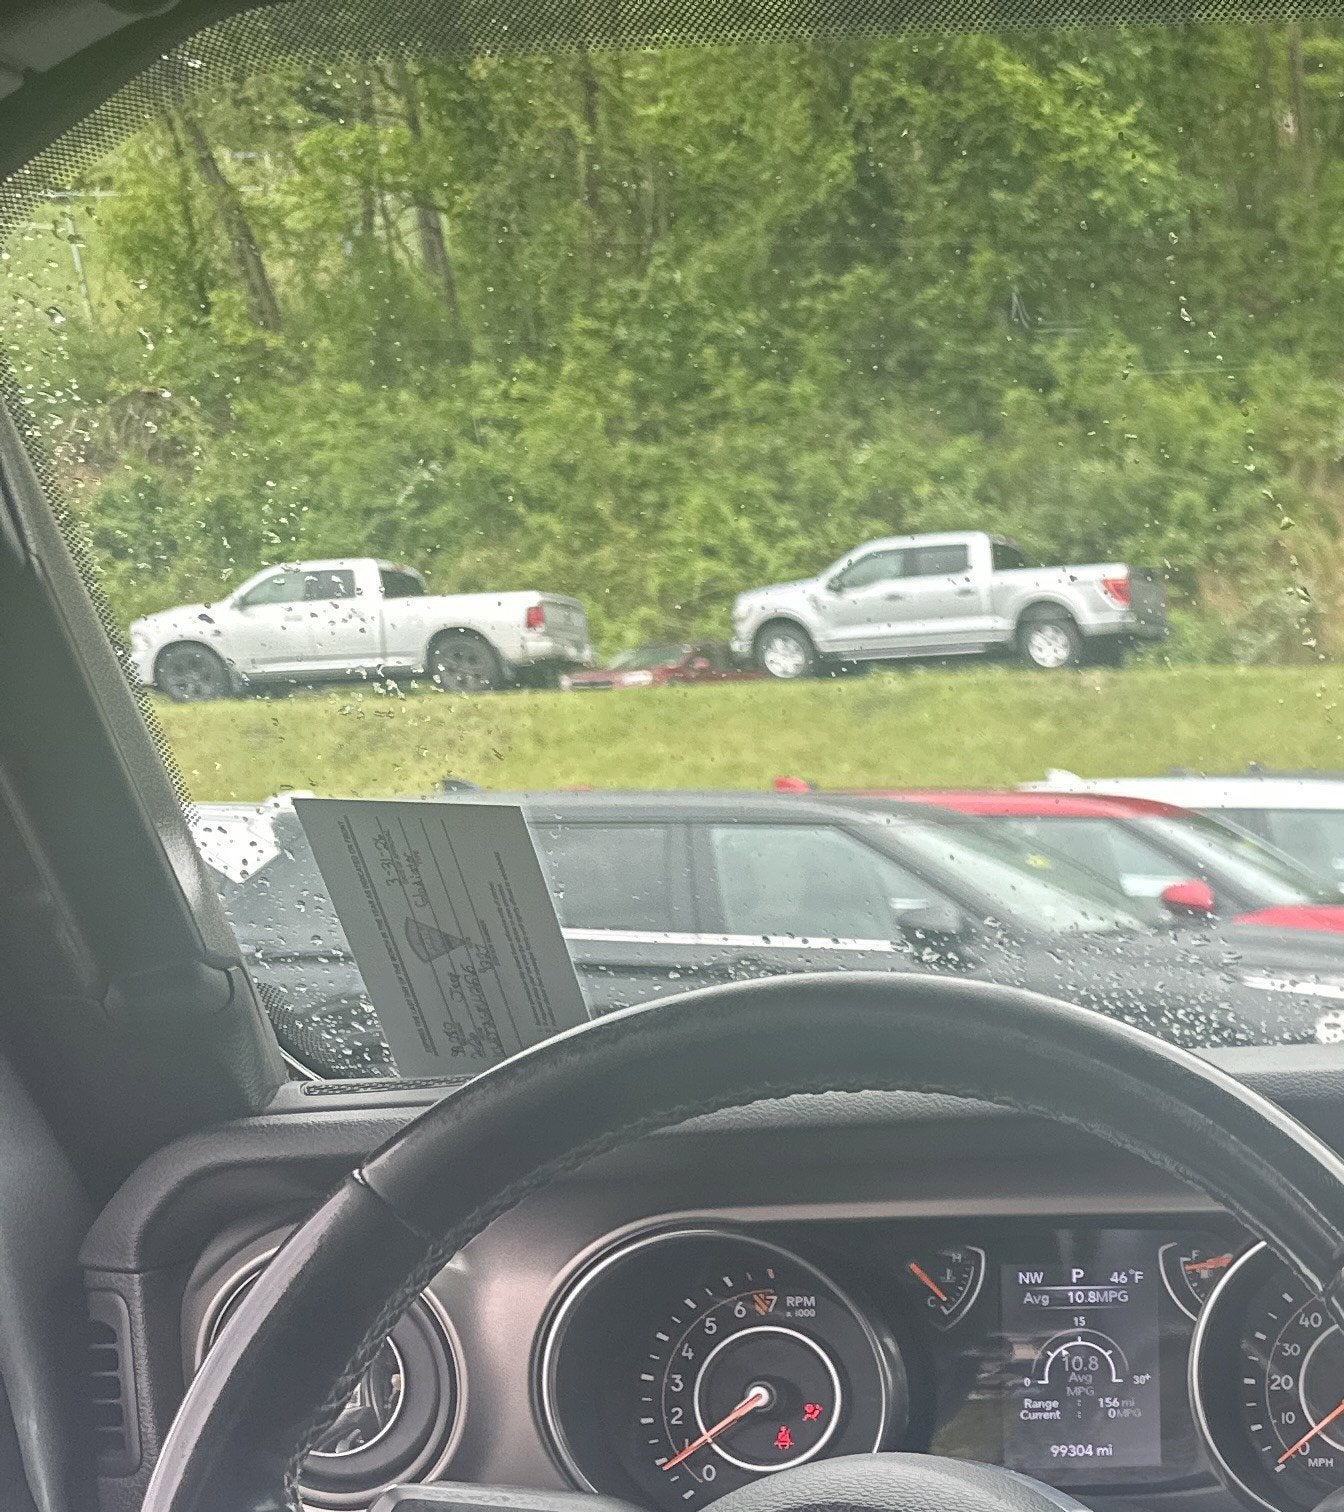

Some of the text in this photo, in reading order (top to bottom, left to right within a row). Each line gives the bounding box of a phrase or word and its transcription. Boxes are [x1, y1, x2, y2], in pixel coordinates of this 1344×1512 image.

[1018, 1272, 1043, 1284] NW
[1071, 1268, 1085, 1283] P
[765, 1296, 778, 1312] 7
[786, 1296, 816, 1307] RPM
[927, 1296, 936, 1308] C
[1023, 1292, 1050, 1306] Avg
[734, 1302, 746, 1318] 6
[704, 1318, 717, 1335] 5
[1073, 1317, 1086, 1326] 15
[1299, 1313, 1322, 1328] 40
[681, 1345, 695, 1360] 4
[1282, 1343, 1300, 1357] 30
[1062, 1356, 1099, 1371] 10.8
[671, 1375, 684, 1392] 3
[1023, 1378, 1031, 1387] 0
[1068, 1373, 1093, 1385] Avg
[1270, 1375, 1293, 1390] 20
[1066, 1386, 1095, 1397] MPG
[1024, 1398, 1135, 1412] Range 156 mi
[670, 1408, 684, 1425] 2
[1020, 1410, 1061, 1420] Current
[1281, 1411, 1295, 1424] 10
[1050, 1444, 1113, 1457] 99304 mi
[1307, 1458, 1334, 1468] MPH
[702, 1465, 716, 1481] 0
